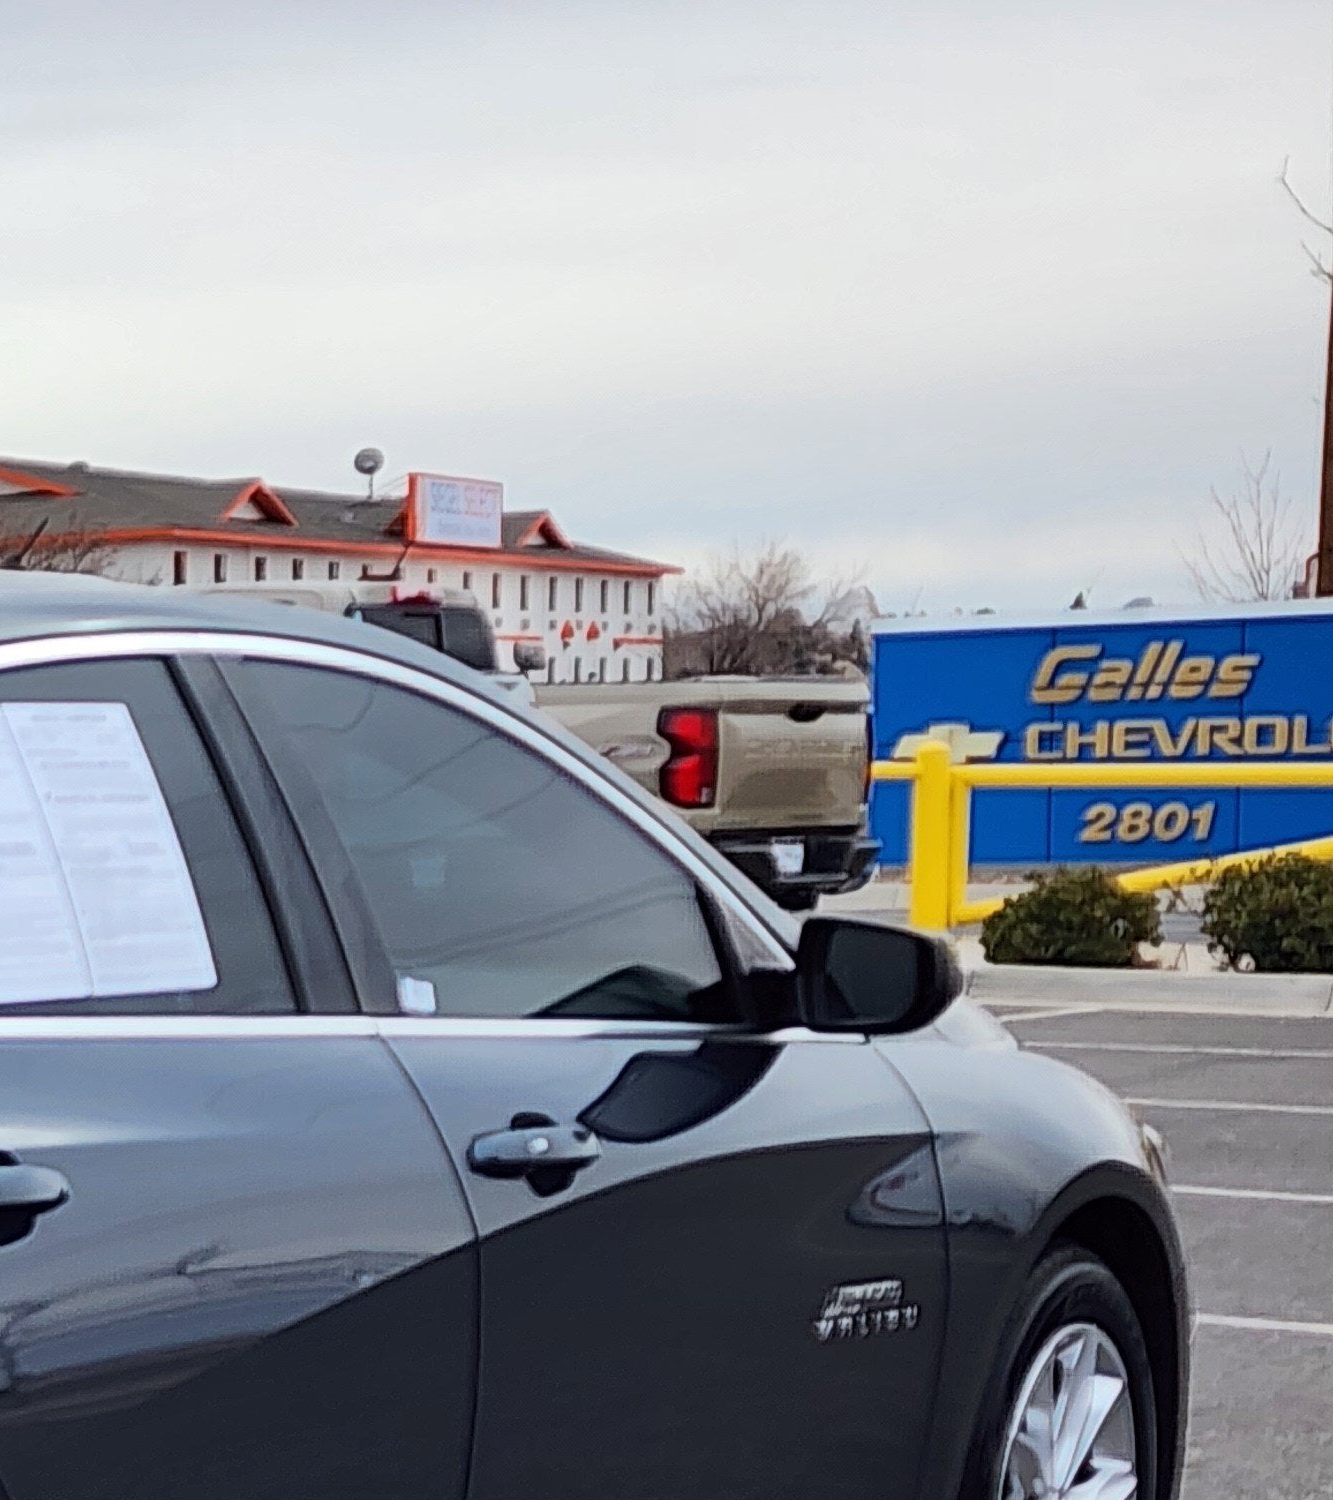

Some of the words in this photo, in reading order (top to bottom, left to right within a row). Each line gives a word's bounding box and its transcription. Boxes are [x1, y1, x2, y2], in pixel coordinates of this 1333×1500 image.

[1030, 639, 1263, 703] Galles
[1024, 712, 1333, 760] CHEVROL
[1078, 800, 1217, 842] 2801
